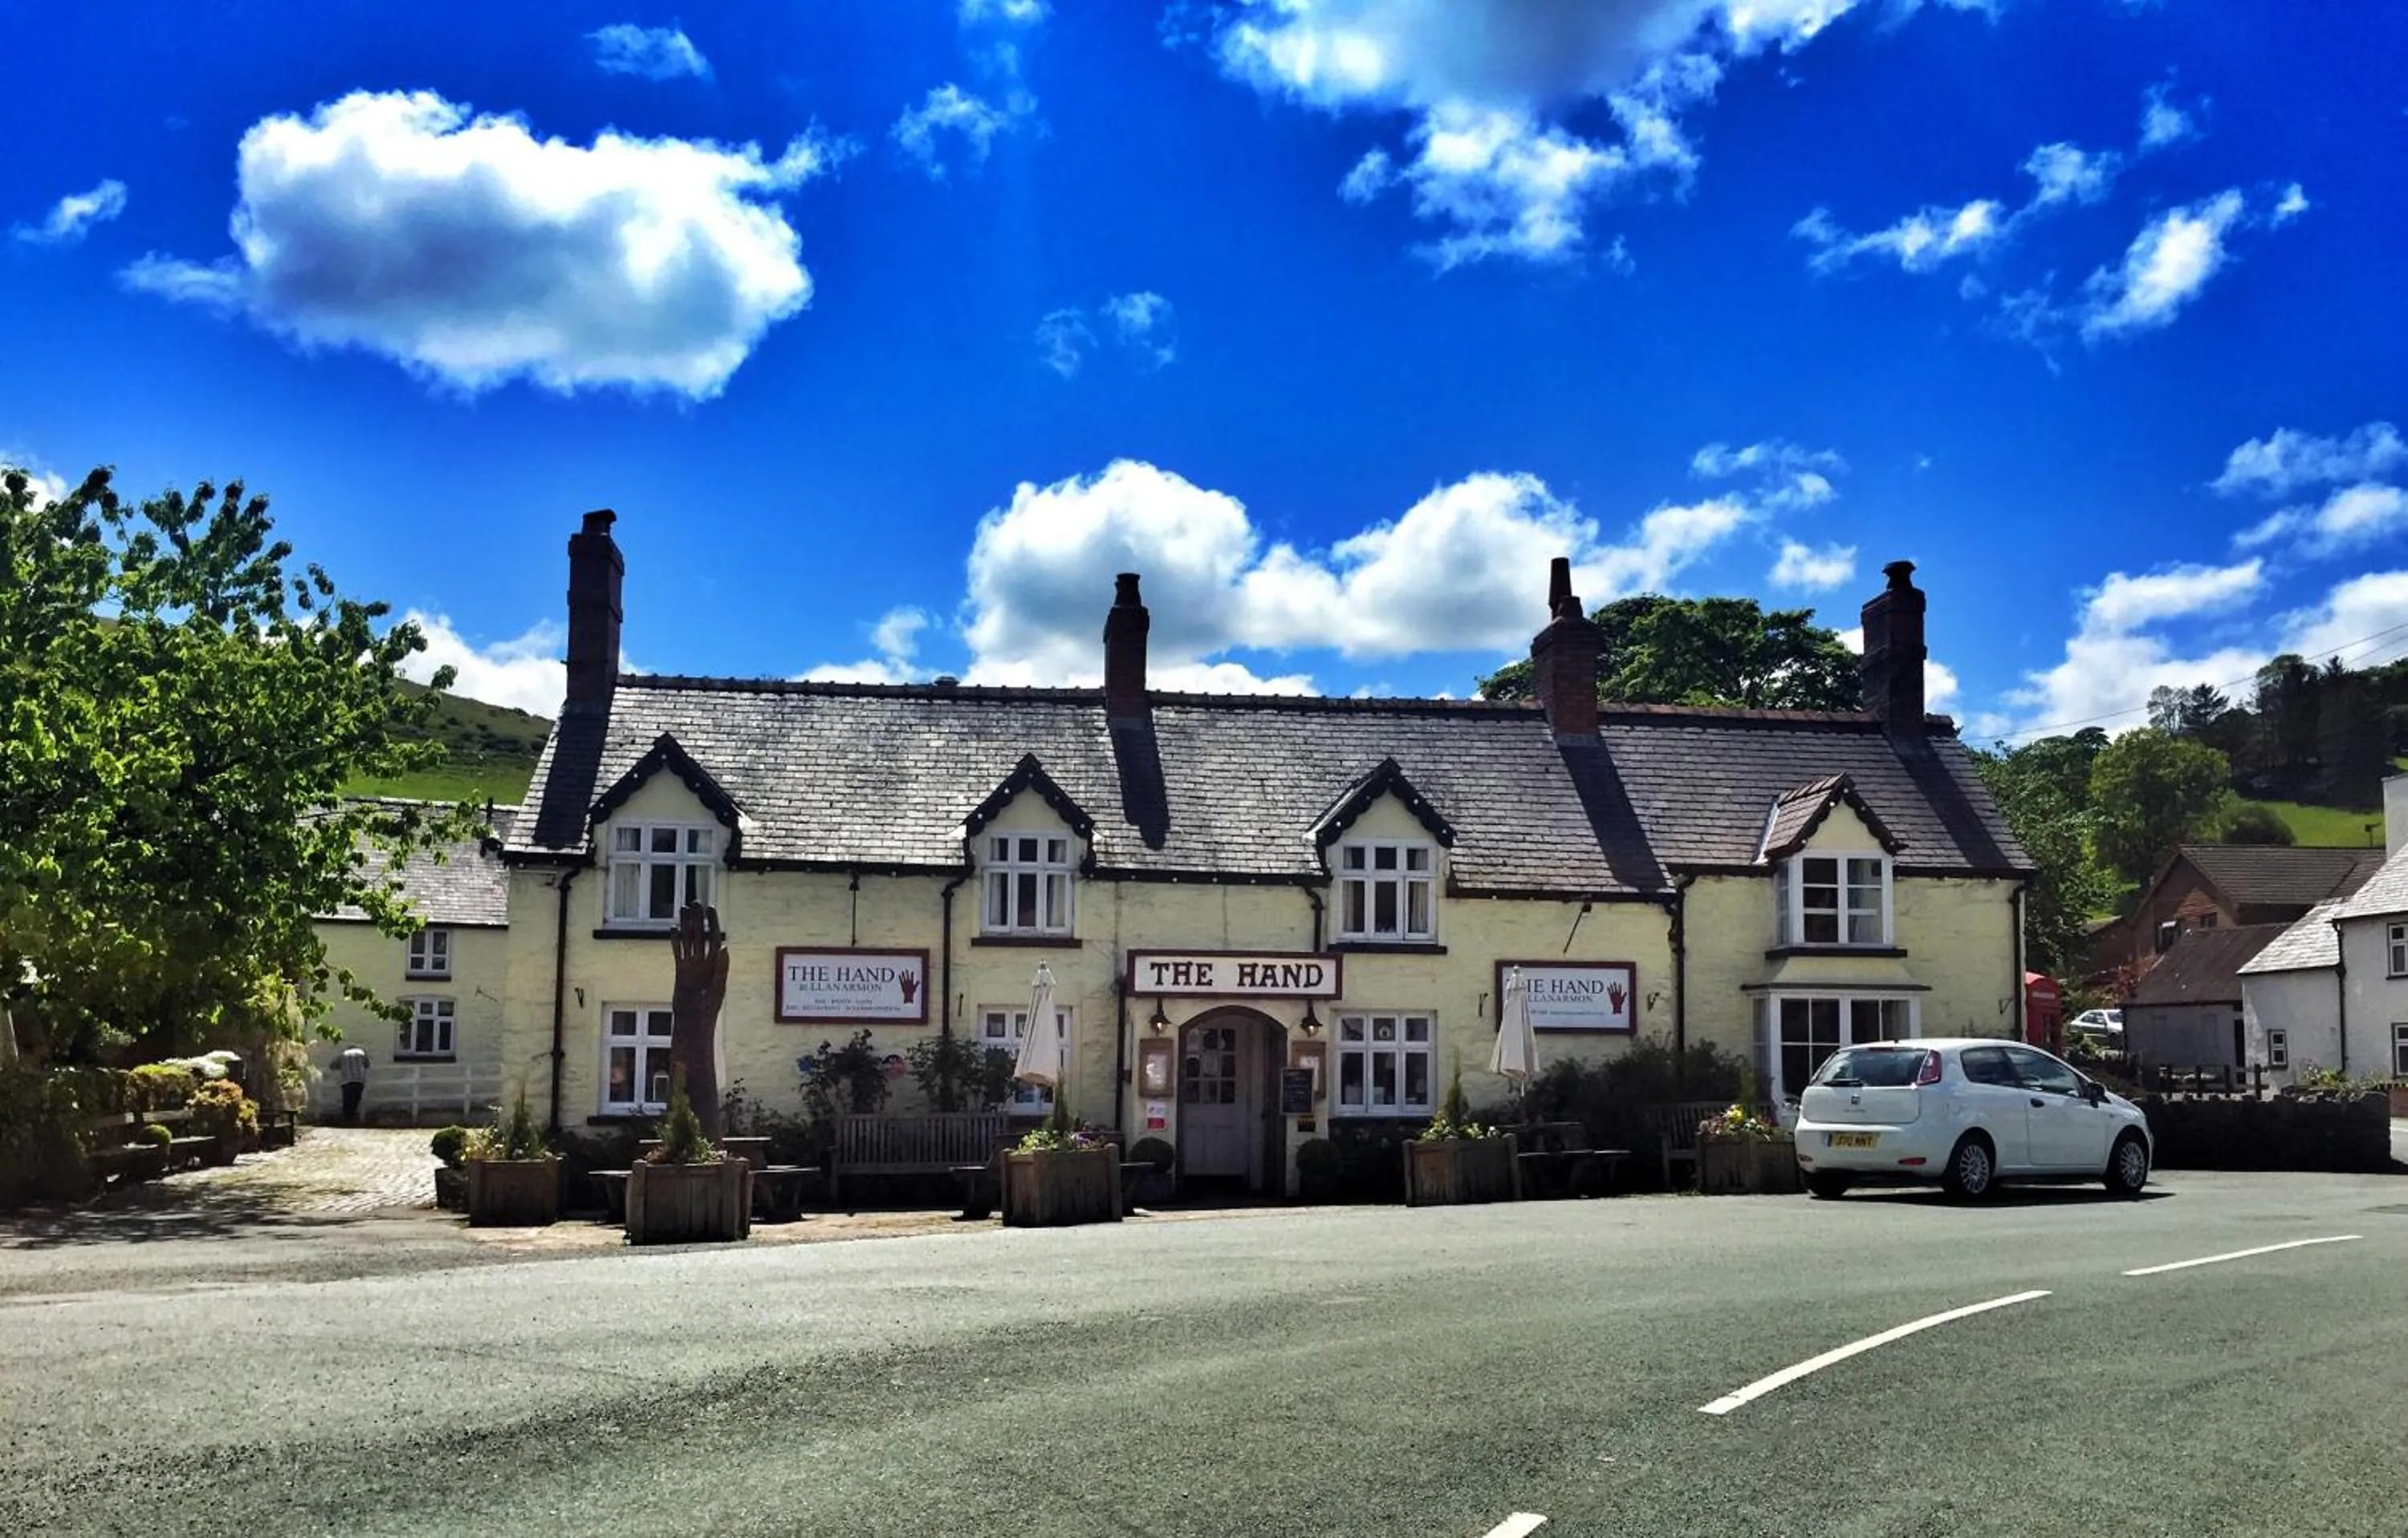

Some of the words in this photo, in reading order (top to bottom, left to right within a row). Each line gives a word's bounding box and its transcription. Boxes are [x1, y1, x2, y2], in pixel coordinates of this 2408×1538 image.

[787, 966, 829, 982] THE
[836, 966, 895, 983] HAND
[1149, 961, 1214, 987] THE
[1237, 962, 1324, 988] HAND
[811, 982, 882, 993] LLANARMON
[1551, 979, 1605, 995] HAND
[1527, 995, 1593, 1003] LLANARMON
